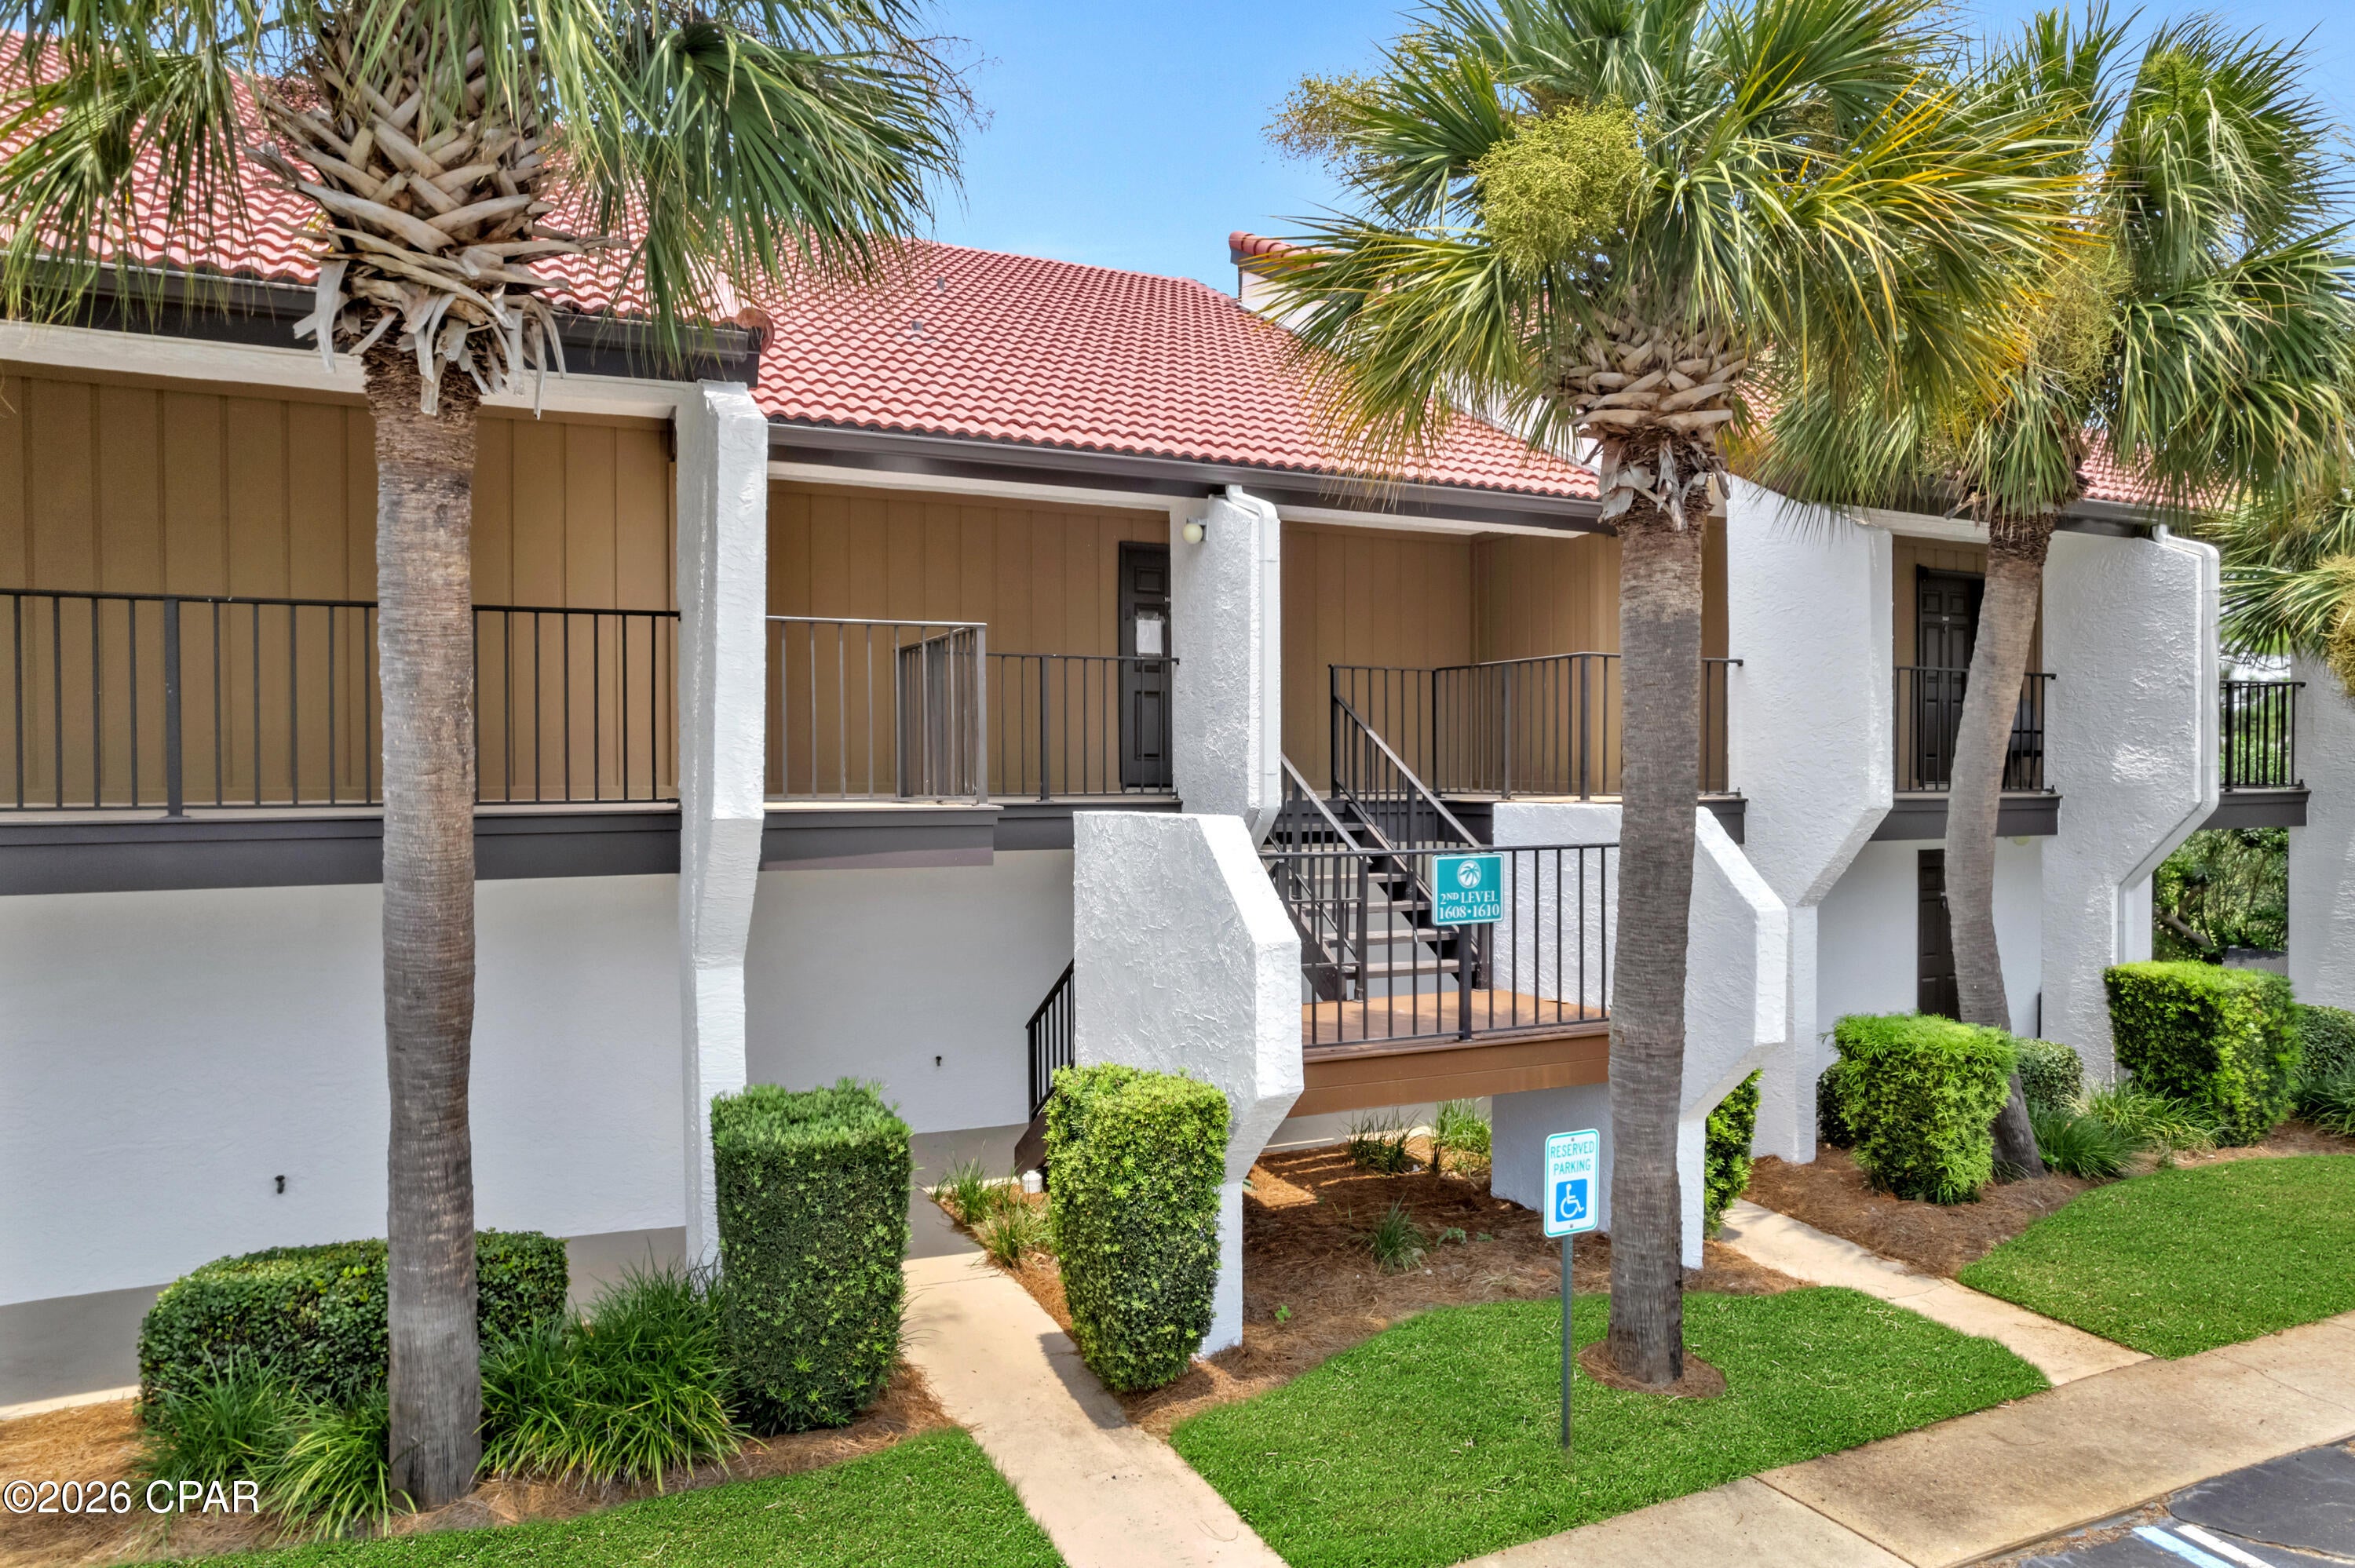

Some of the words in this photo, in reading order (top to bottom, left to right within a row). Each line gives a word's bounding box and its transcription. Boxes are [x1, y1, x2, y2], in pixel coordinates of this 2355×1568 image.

[1440, 892, 1459, 905] 2ND
[1461, 890, 1499, 903] LEVEL
[1550, 1140, 1594, 1159] RESERVED
[1554, 1158, 1591, 1176] PARKING
